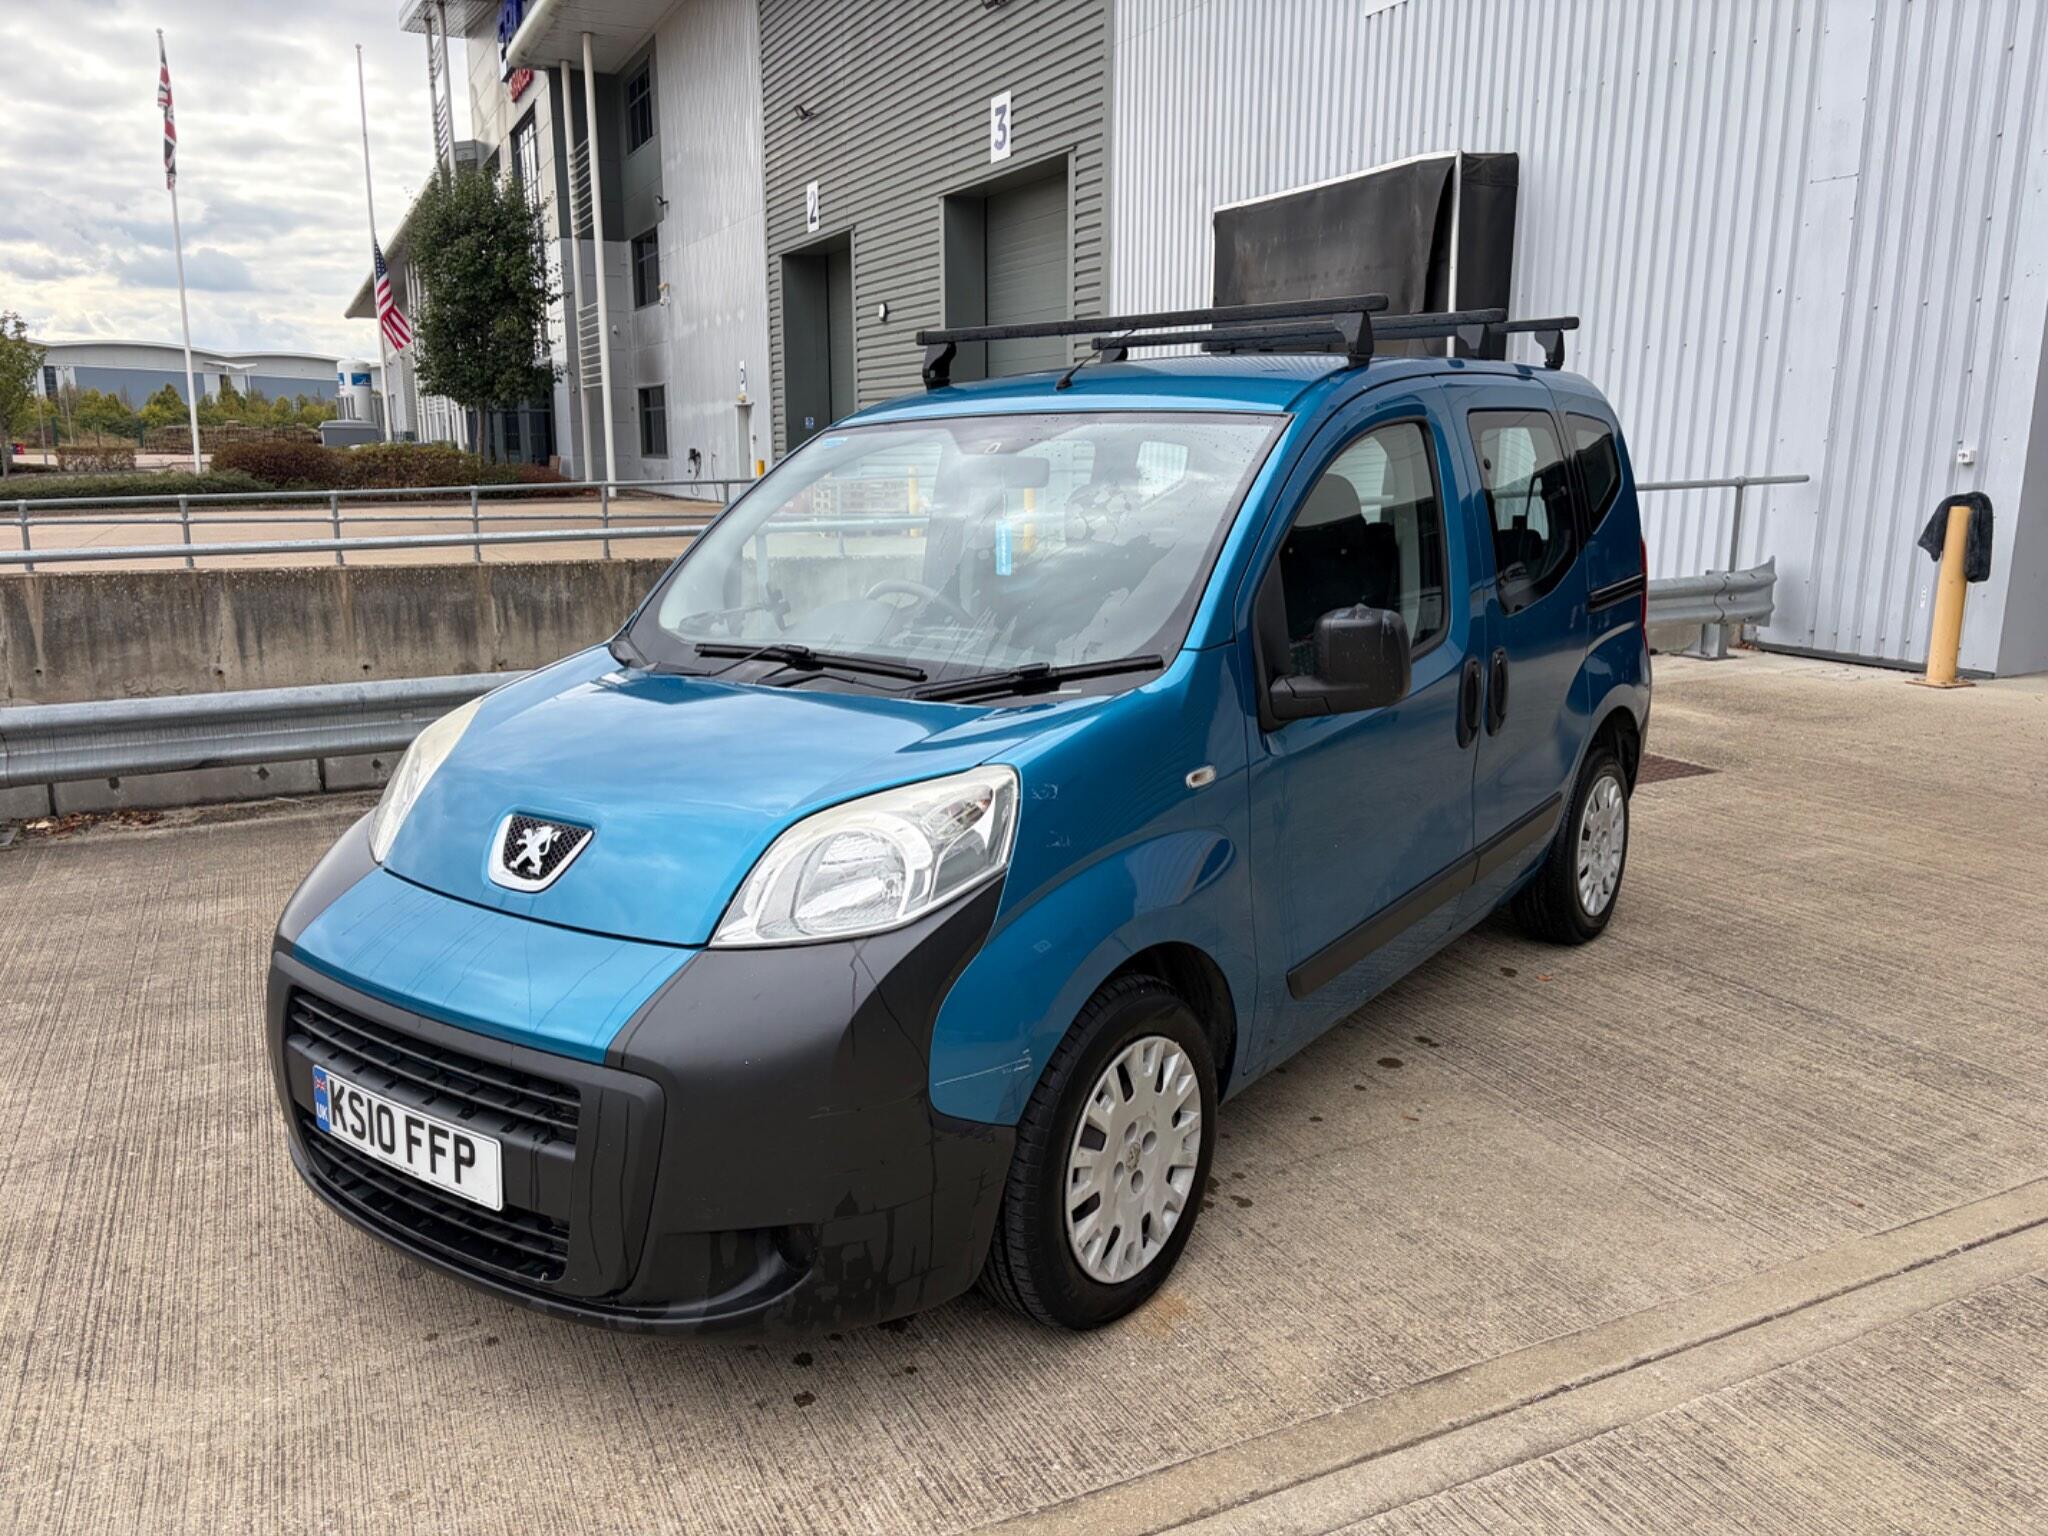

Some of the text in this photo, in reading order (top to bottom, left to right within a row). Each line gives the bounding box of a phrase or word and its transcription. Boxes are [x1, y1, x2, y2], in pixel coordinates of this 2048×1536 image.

[994, 104, 1008, 150] 3
[809, 190, 818, 224] 2
[316, 1101, 329, 1121] UK
[329, 1079, 476, 1185] KS10 FFP
